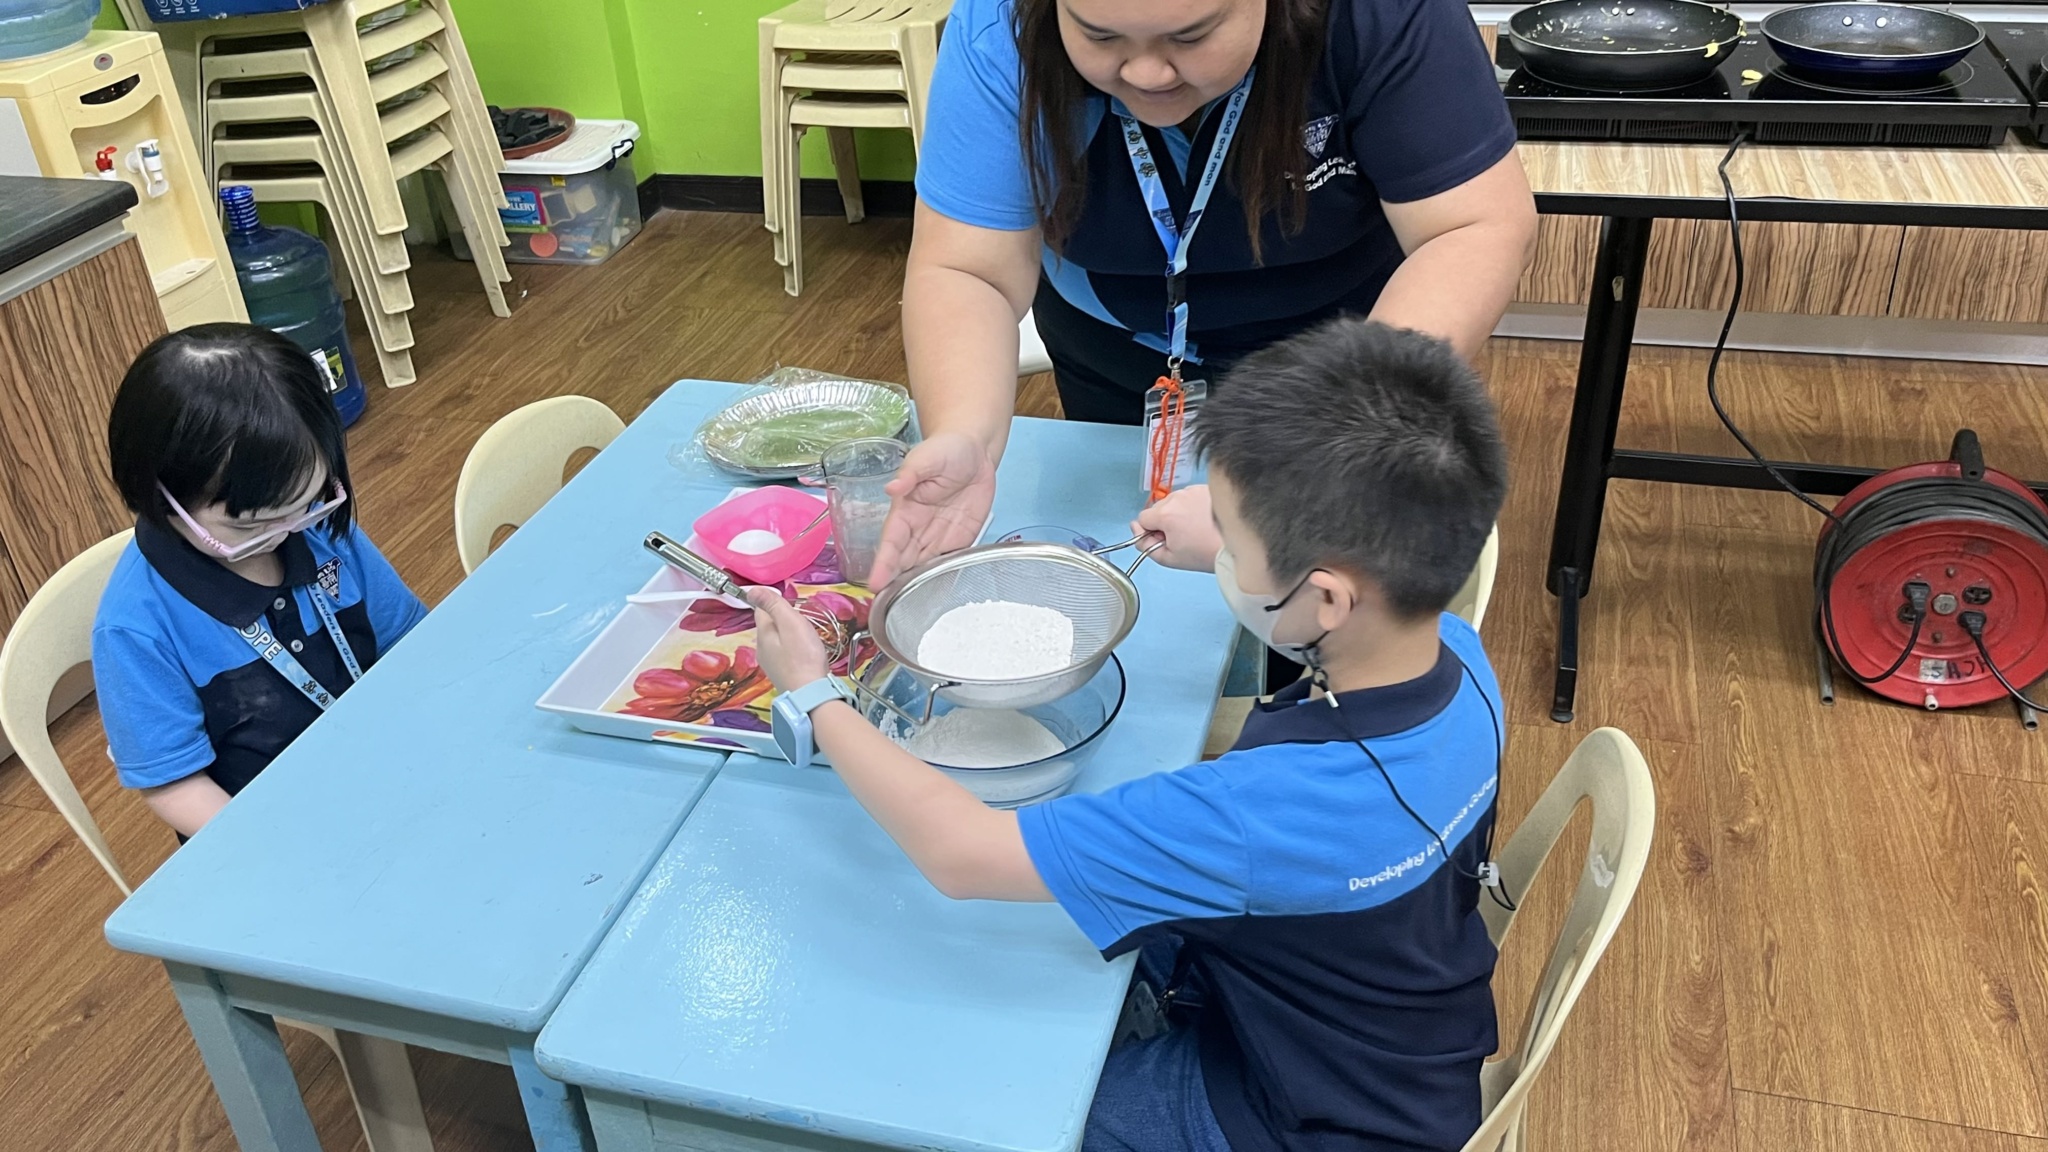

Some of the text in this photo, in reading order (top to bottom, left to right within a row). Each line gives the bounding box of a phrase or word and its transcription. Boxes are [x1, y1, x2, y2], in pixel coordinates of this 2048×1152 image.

[1223, 110, 1237, 134] God
[1214, 137, 1226, 160] and
[1204, 161, 1218, 187] man
[1304, 177, 1324, 192] God
[239, 621, 284, 662] OPE
[314, 592, 336, 630] Leaders
[333, 632, 344, 646] for
[342, 647, 357, 669] God
[1349, 851, 1426, 892] Developing
